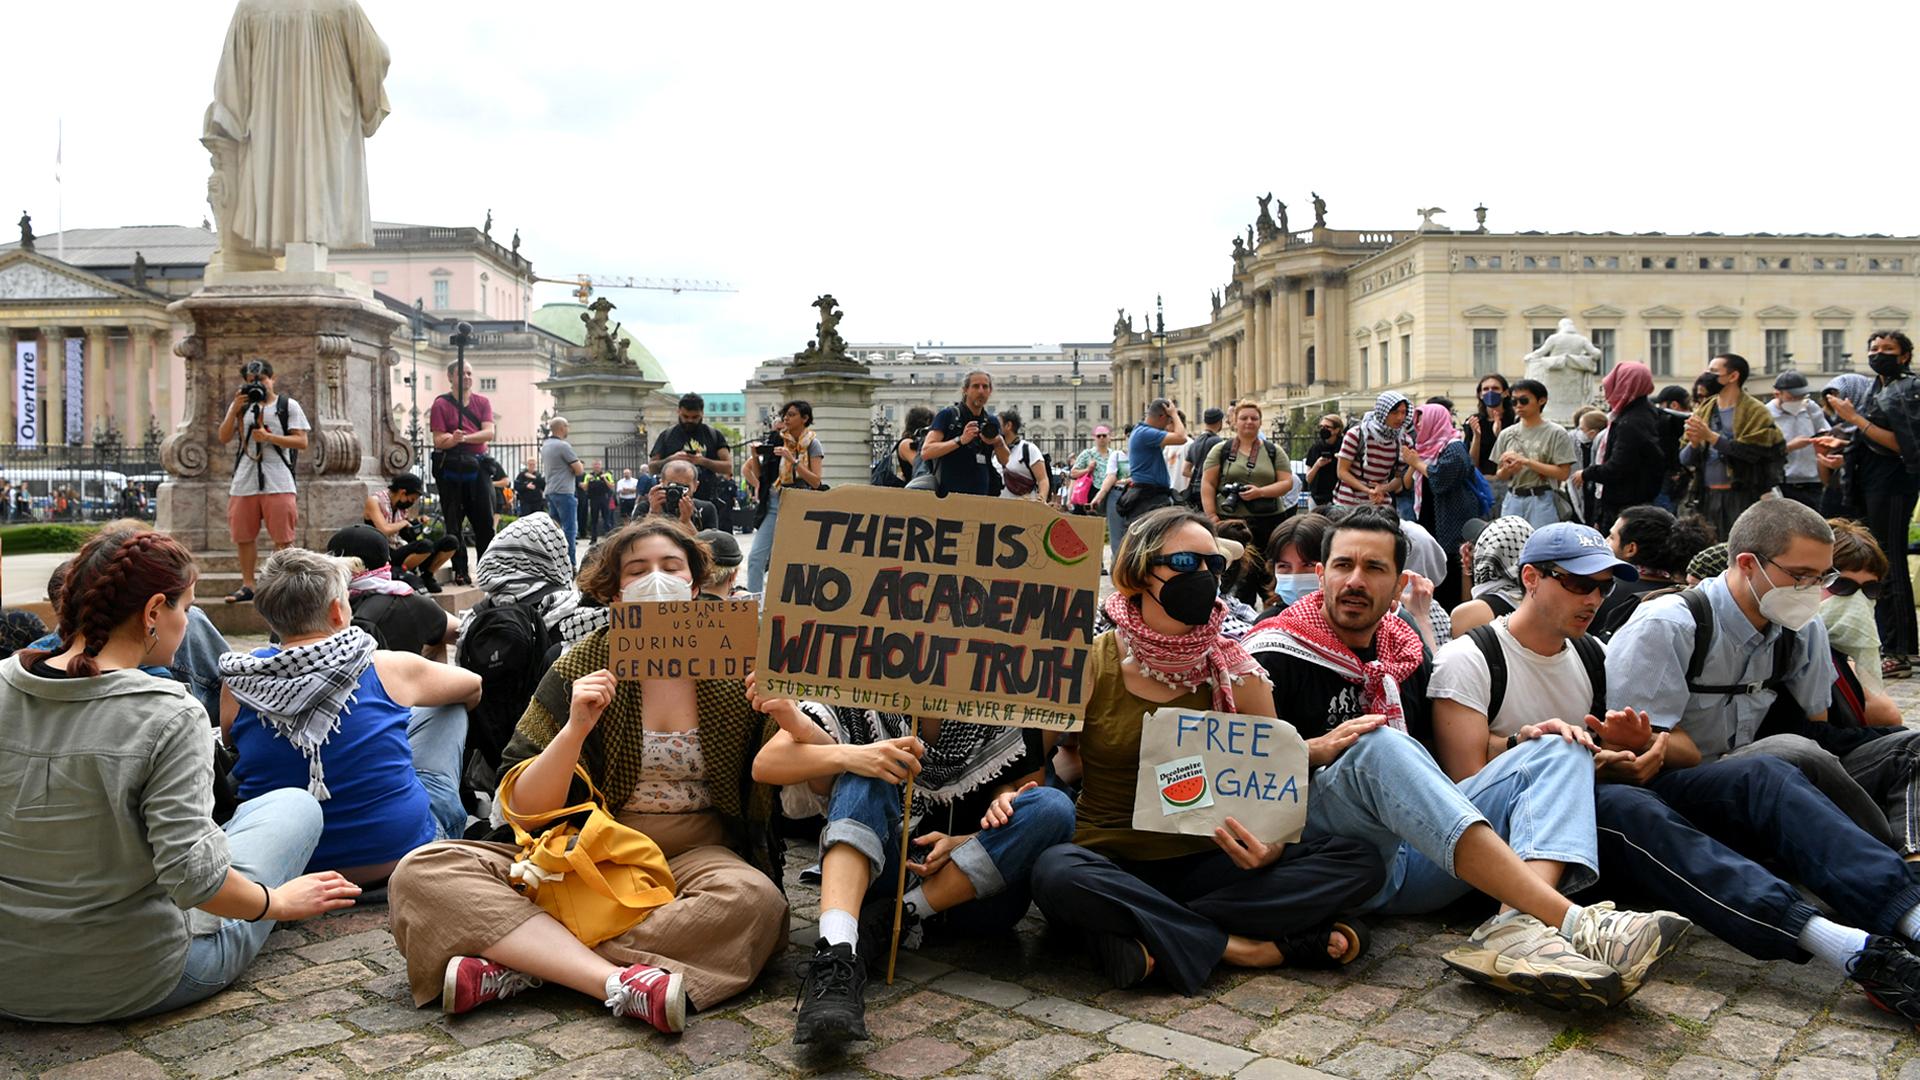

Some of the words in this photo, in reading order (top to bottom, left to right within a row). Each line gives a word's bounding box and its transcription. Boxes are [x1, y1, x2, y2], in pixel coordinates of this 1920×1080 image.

[21, 351, 36, 440] Overture
[804, 511, 964, 566] THERE
[976, 523, 1029, 570] IS
[611, 604, 642, 630] NO
[658, 602, 749, 615] BUSINESS
[697, 611, 709, 619] AS
[781, 563, 852, 613] NO
[861, 566, 1095, 645] ACADEMIA
[673, 619, 725, 630] USUAL
[618, 635, 698, 652] DURING
[719, 635, 732, 650] A
[615, 656, 757, 679] GENOCIDE
[768, 616, 960, 687] WITHOUT
[967, 638, 1088, 705] TRUTH
[767, 679, 841, 700] STUDENTS
[852, 687, 911, 712] UNITED
[922, 695, 948, 712] WILL
[956, 700, 1000, 721] NEVER
[1003, 703, 1016, 721] BE
[1021, 705, 1076, 731] DEFEATED
[1177, 714, 1273, 758] FREE
[1159, 761, 1202, 781] Decolonize
[1167, 768, 1204, 785] Palestine
[1215, 768, 1299, 804] GAZA
